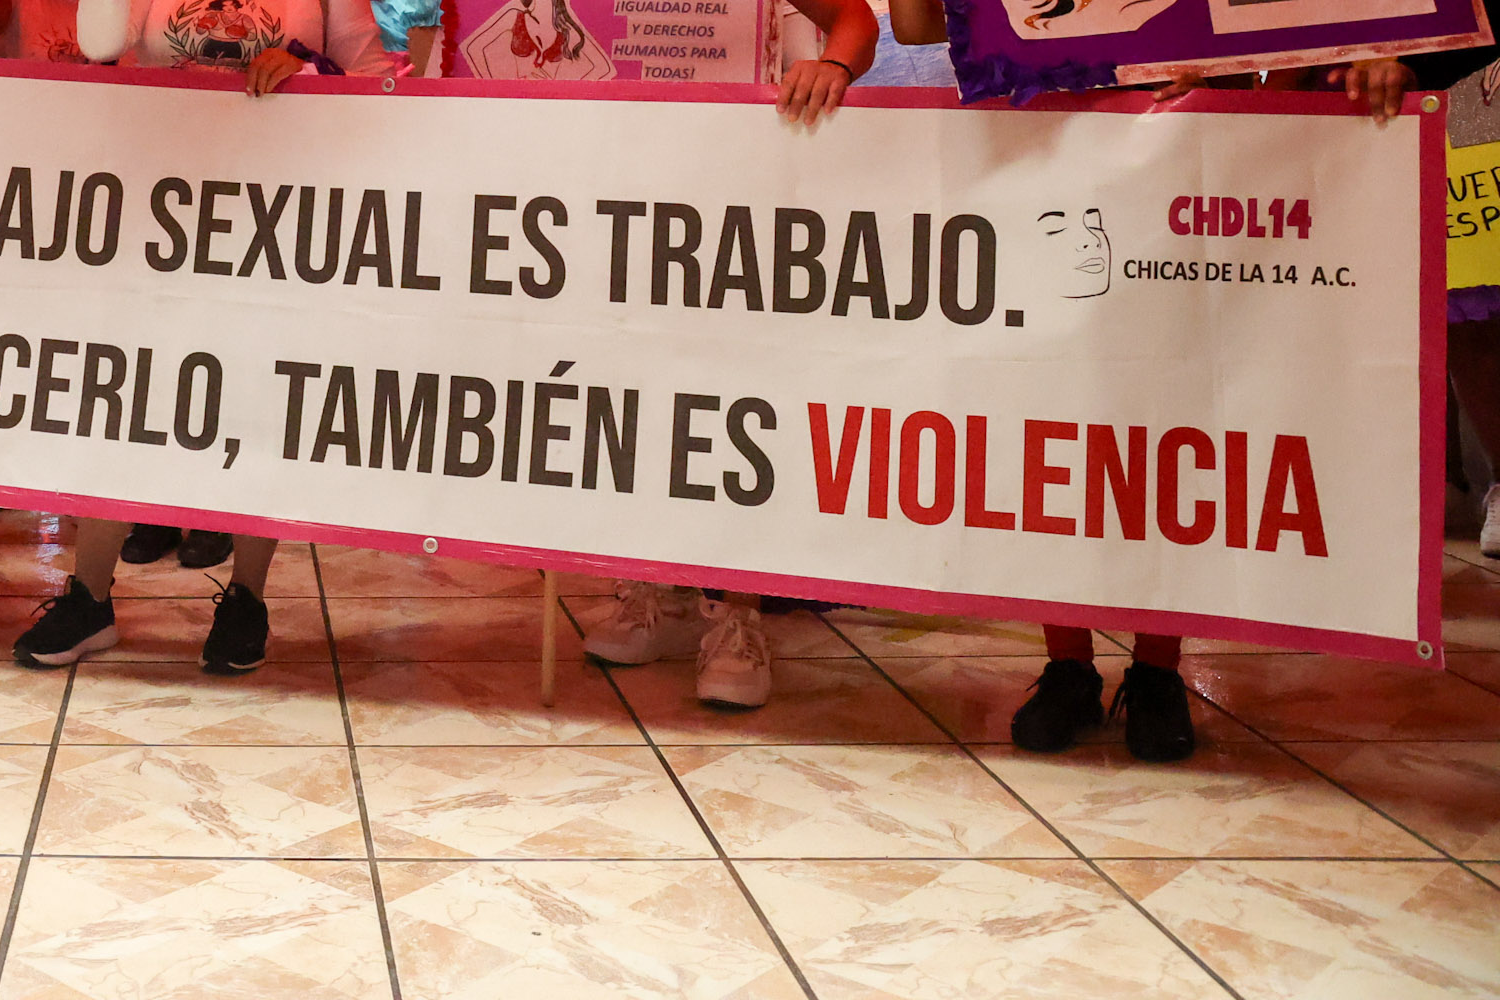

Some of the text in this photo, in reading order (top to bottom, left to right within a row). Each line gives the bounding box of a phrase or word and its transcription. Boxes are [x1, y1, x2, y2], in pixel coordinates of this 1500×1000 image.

[615, 0, 729, 15] ¡IGUALDAD REAL
[632, 24, 715, 37] Y DERECHOS
[614, 45, 727, 59] HUMANOS PARA
[645, 66, 695, 79] TODAS!
[1168, 195, 1312, 240] CHDL14
[145, 176, 442, 292] SEXUAL
[469, 193, 569, 300] ES
[596, 199, 1025, 328] TRABAJO.
[1124, 259, 1357, 288] CHICAS DE LA 14 A.C.
[275, 360, 640, 493] TAMBIÉN
[669, 393, 778, 507] ES
[807, 403, 1329, 558] VIOLENCIA
